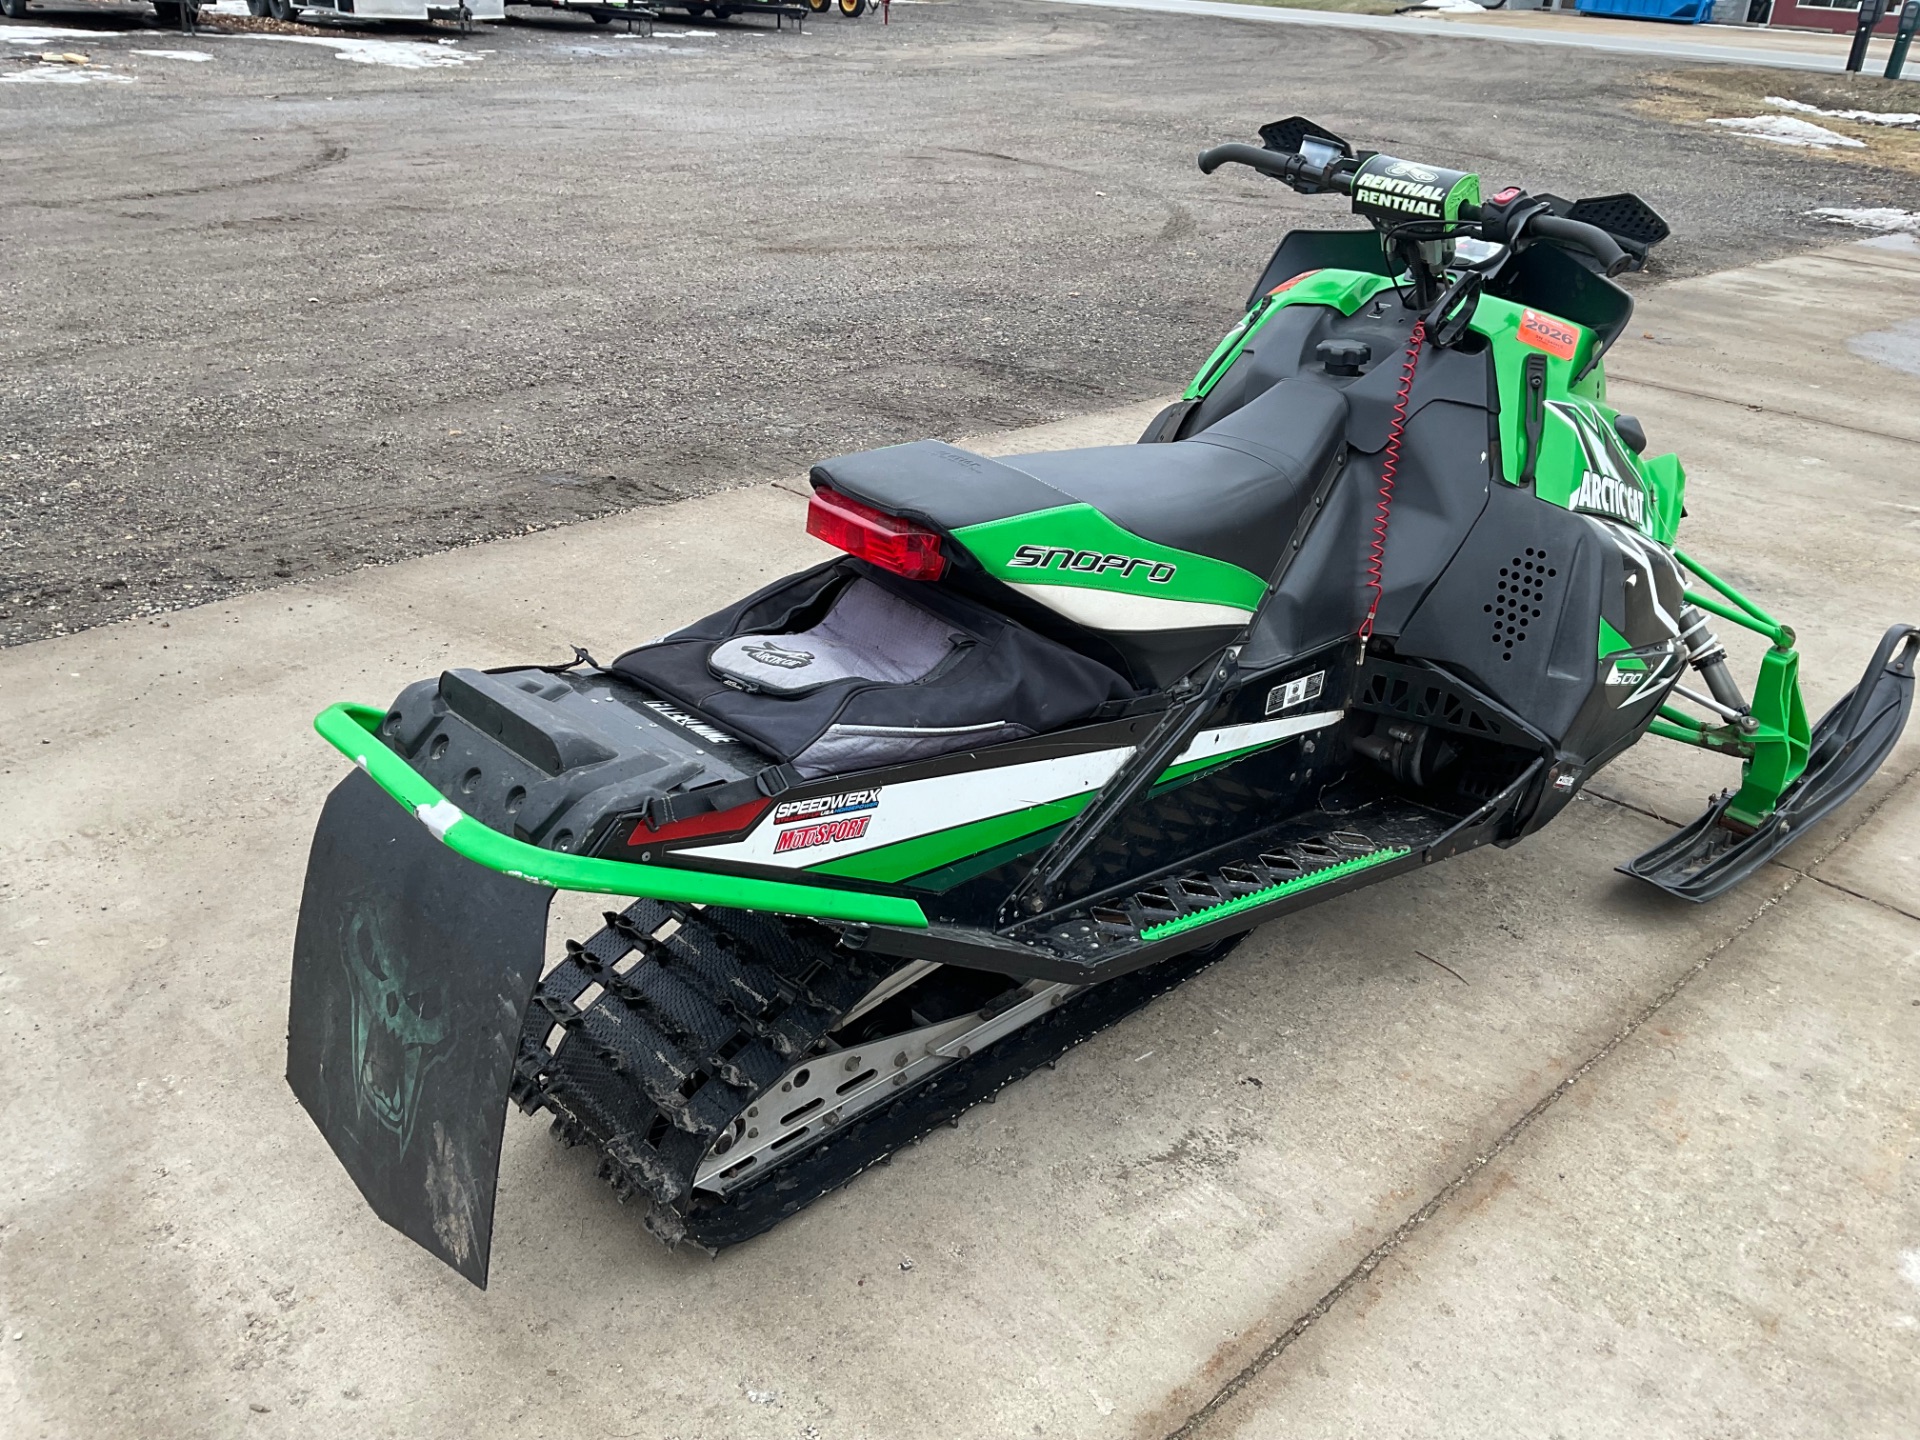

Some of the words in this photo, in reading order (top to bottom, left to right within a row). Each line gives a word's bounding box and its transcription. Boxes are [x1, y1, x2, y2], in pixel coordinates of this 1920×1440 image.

[1357, 173, 1443, 201] RENTHAL
[1356, 189, 1440, 217] RENTHAL
[1525, 319, 1573, 345] 2026
[1578, 470, 1626, 518] ARCTIC
[1627, 486, 1644, 523] CAT
[776, 788, 881, 818] SPEEDWERX
